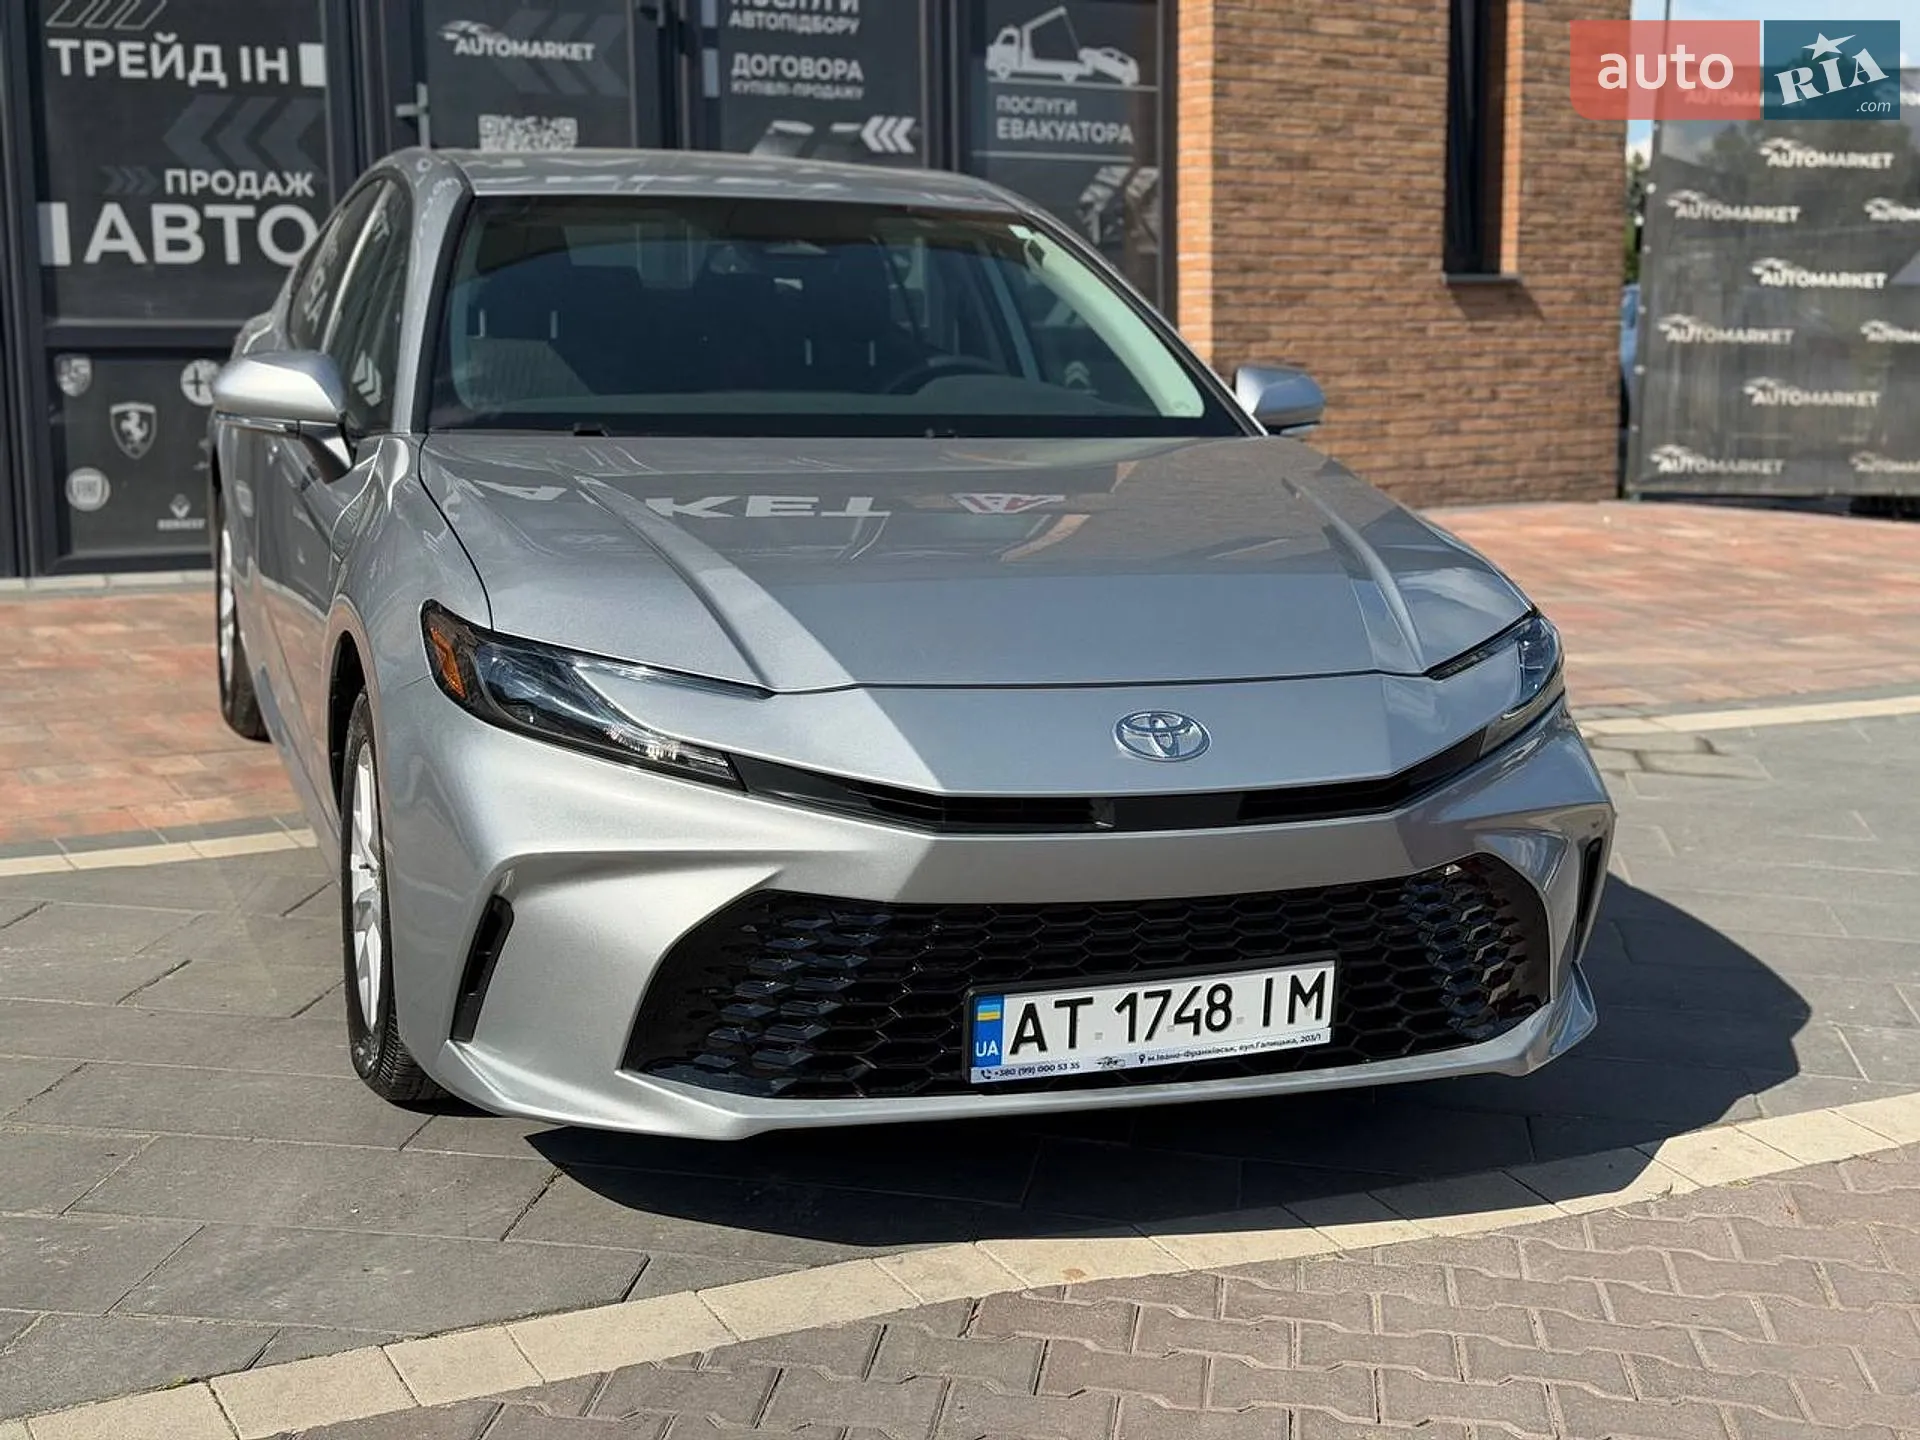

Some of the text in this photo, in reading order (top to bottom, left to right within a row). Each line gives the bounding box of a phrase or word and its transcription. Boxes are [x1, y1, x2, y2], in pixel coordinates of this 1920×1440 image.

[454, 37, 595, 61] AUTOMARKET
[47, 32, 289, 88] ТРЕЙД ІН
[731, 52, 865, 82] ДОГОВОРА
[996, 95, 1078, 115] ПОСЛУГИ
[996, 117, 1134, 144] ЕВАКУАТОРА
[1767, 151, 1894, 169] AUTOMARKET
[164, 168, 315, 200] ПРОДАЖ
[1675, 202, 1800, 223] AUTOMARKET
[83, 202, 320, 267] АВТО
[1760, 271, 1887, 288] AUTOMARKET
[1666, 325, 1794, 344] AUTOMARKET
[1752, 389, 1880, 407] AUTOMARKET
[1659, 456, 1785, 475] AUTOMARKET
[1009, 970, 1326, 1056] AT 1748 IM
[975, 1041, 999, 1058] UA
